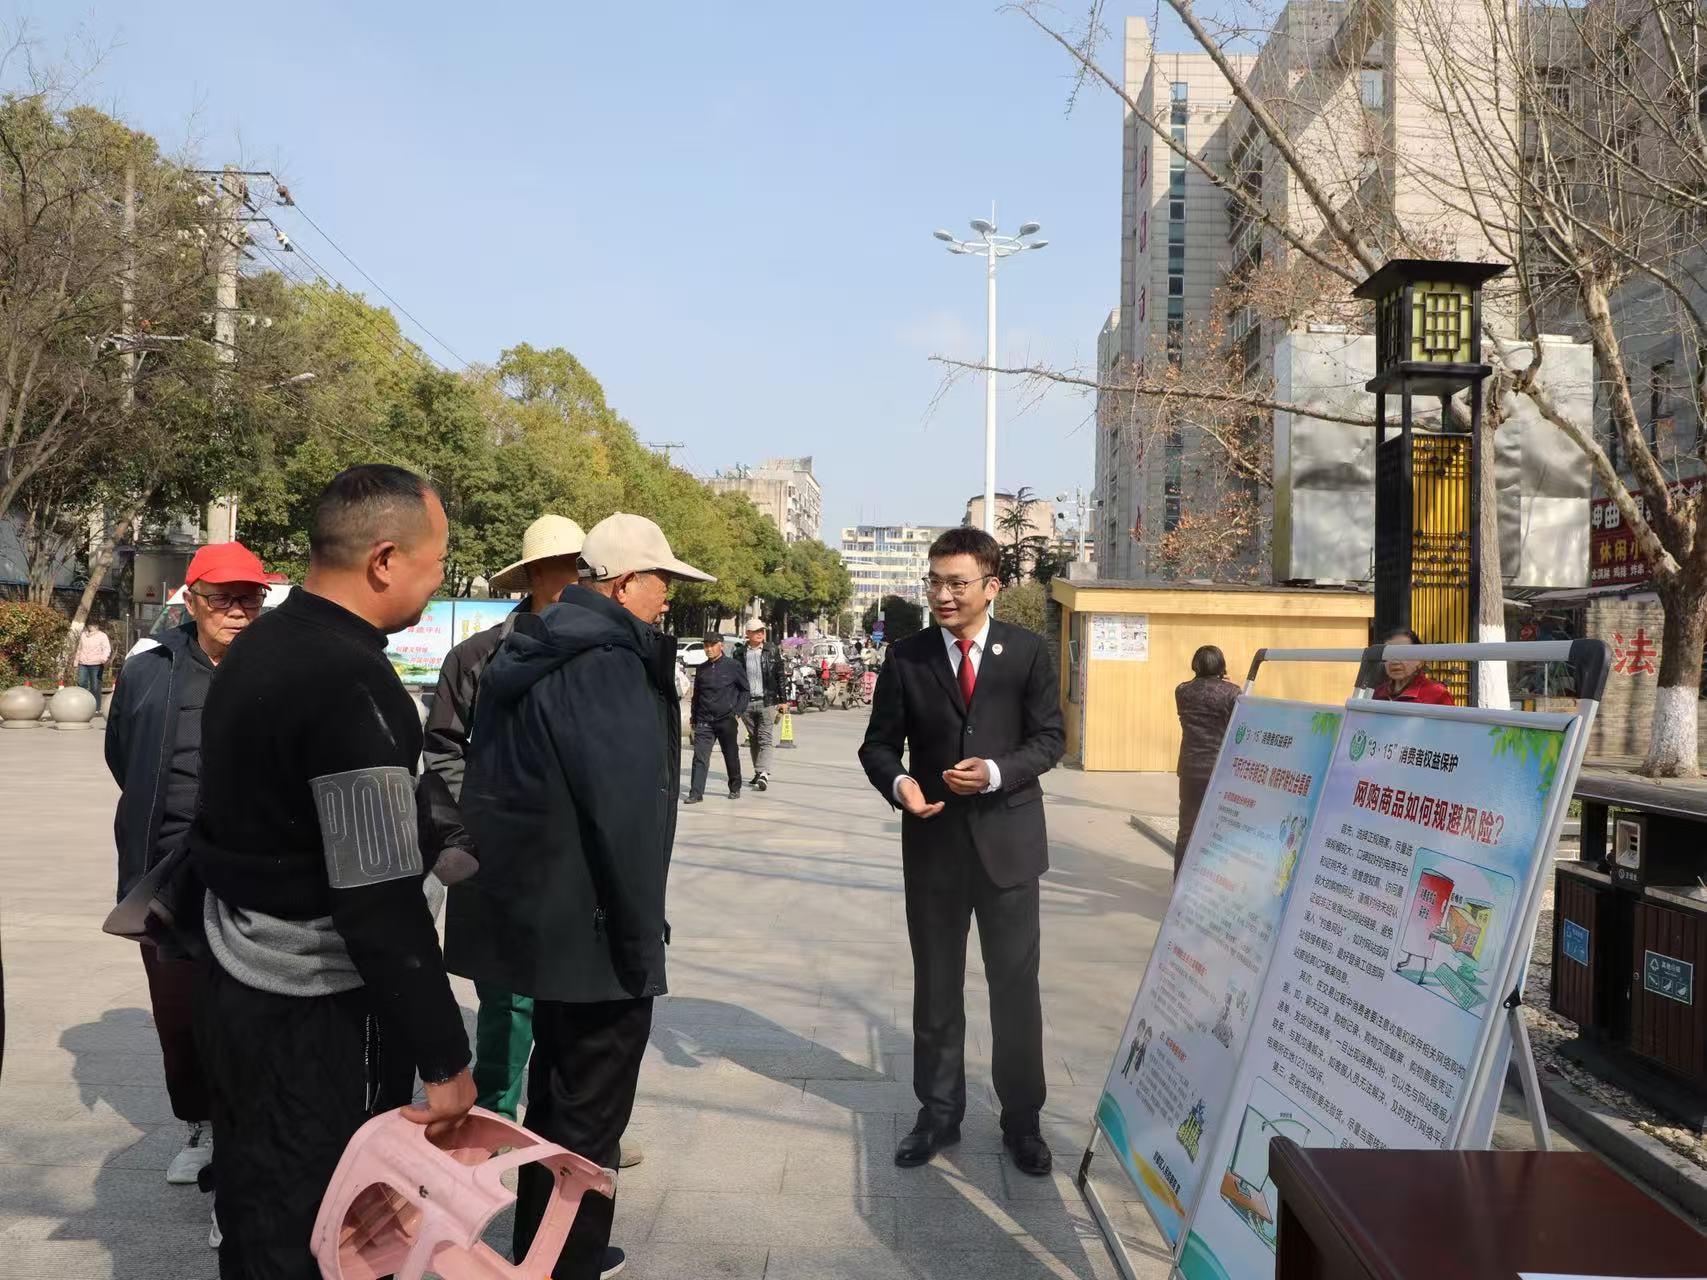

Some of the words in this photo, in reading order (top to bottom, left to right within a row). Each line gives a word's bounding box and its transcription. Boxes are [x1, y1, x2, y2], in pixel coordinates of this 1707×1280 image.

[1613, 628, 1657, 675] 法
[1398, 746, 1459, 774] 消费者权益保护
[1353, 780, 1506, 845] 网购商品如何规避风险?
